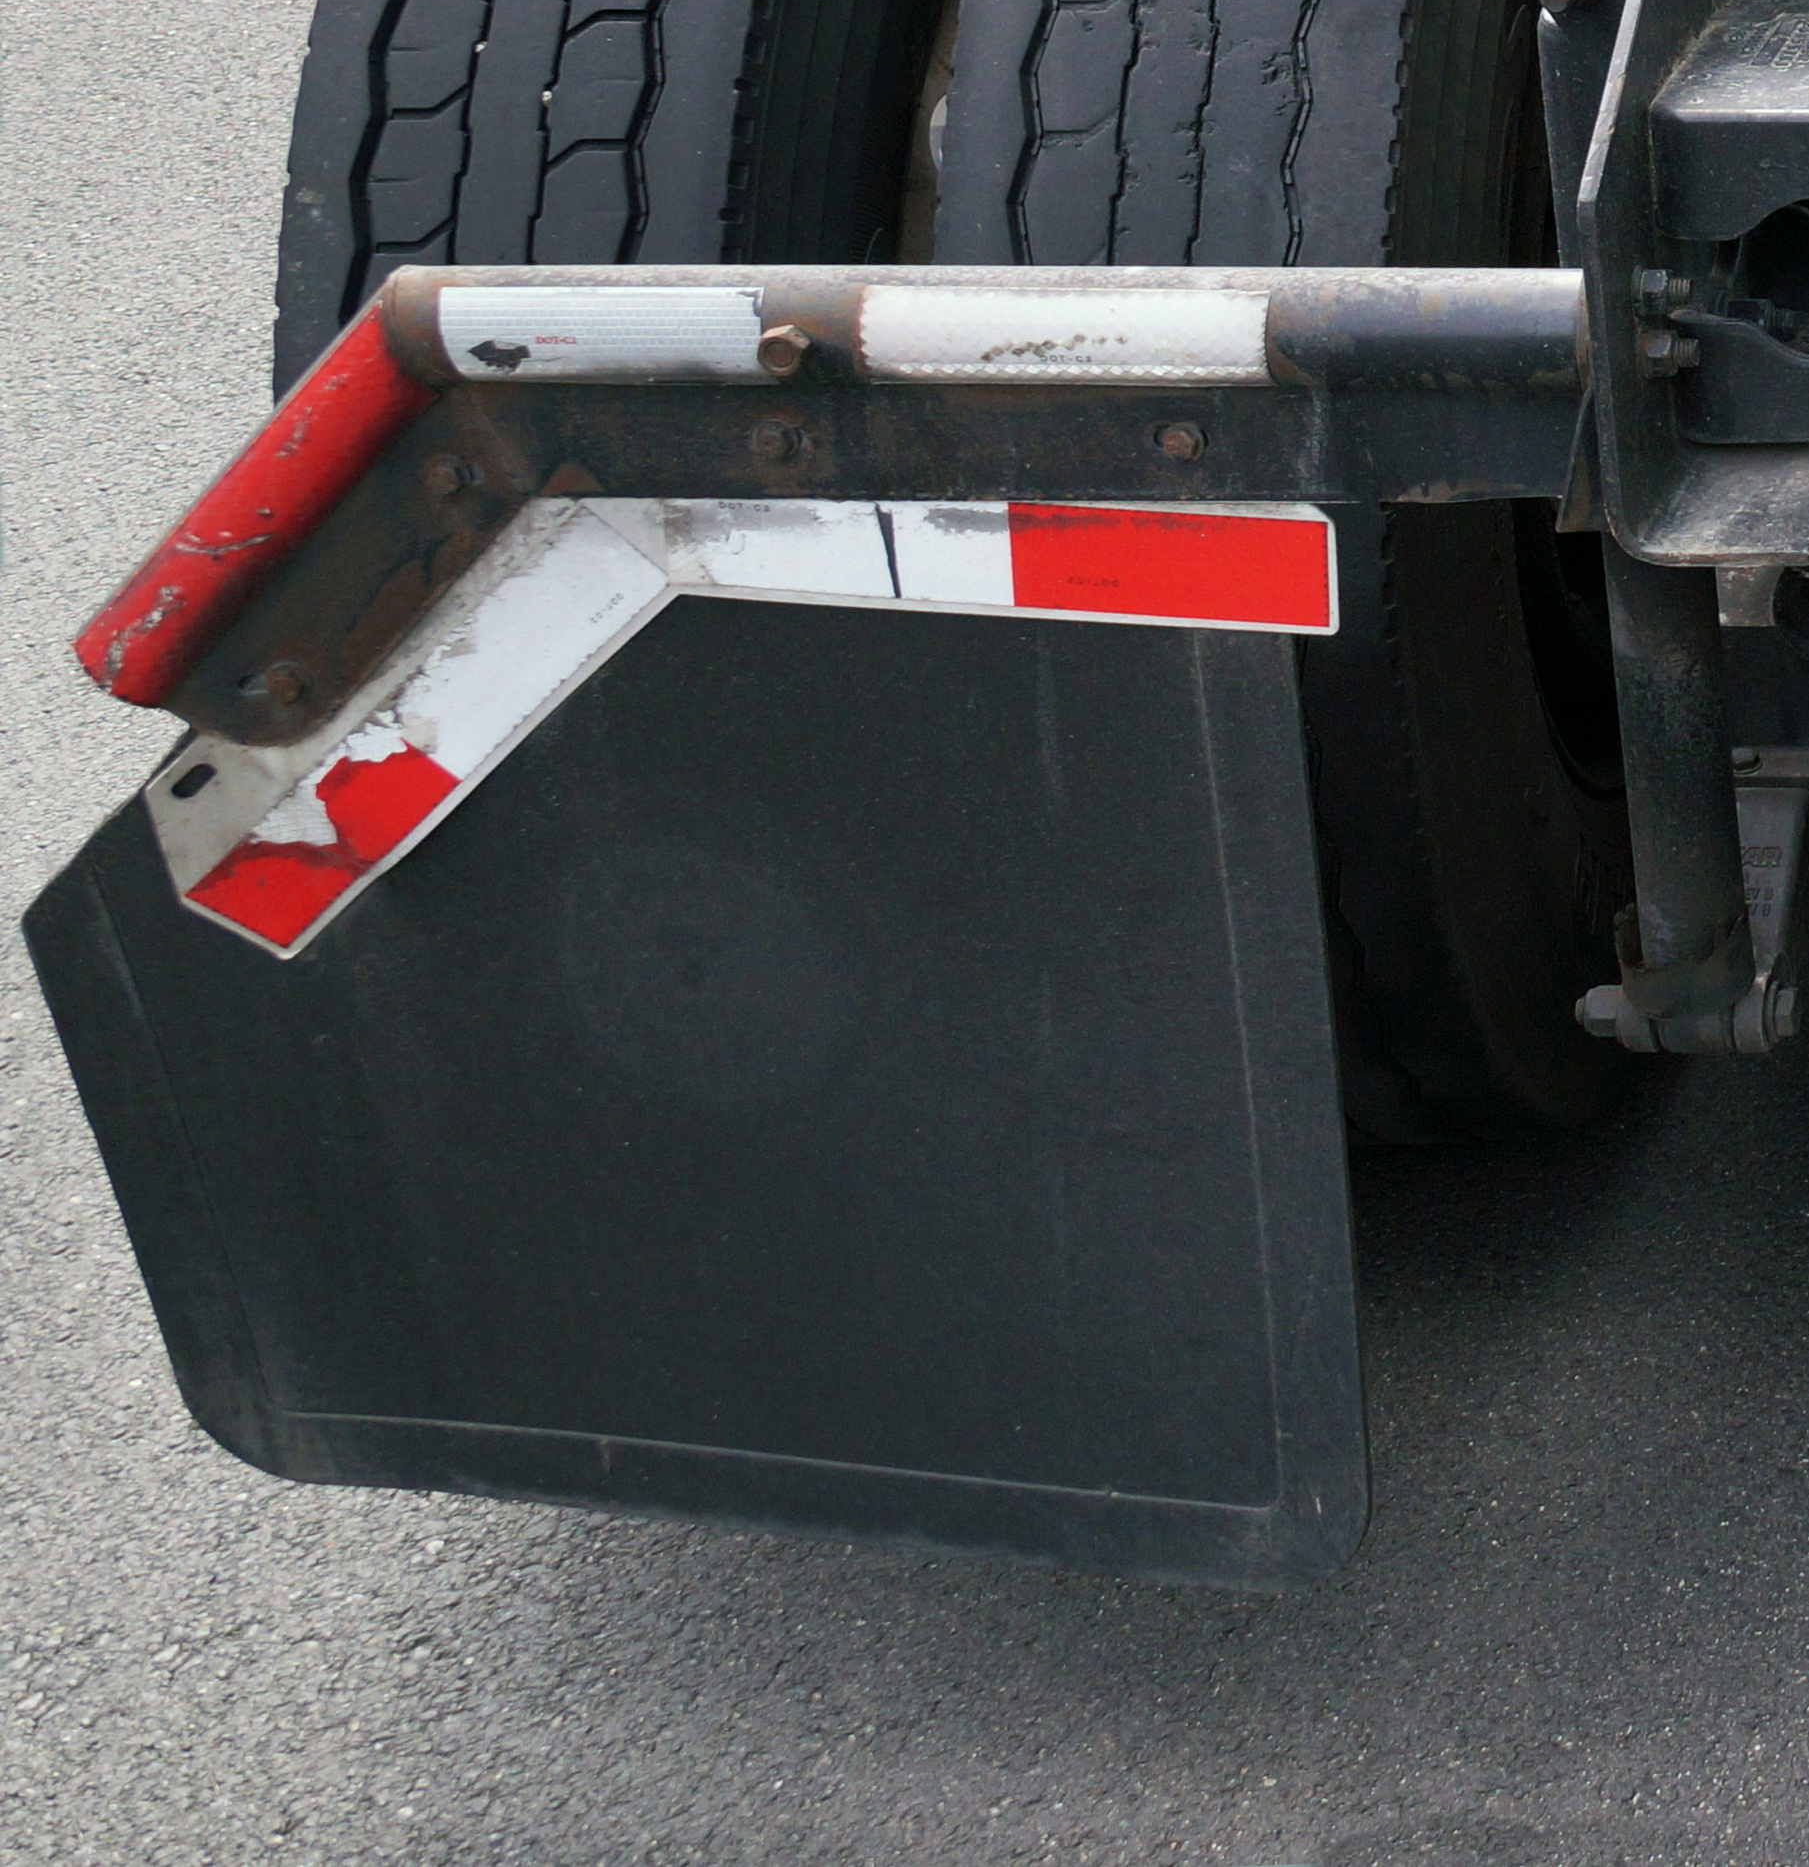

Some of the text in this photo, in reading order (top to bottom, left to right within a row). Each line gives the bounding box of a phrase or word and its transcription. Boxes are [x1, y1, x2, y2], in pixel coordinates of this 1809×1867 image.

[535, 335, 578, 344] DOT-C2
[1040, 355, 1092, 363] DOT-C2
[718, 501, 770, 512] DOT-C2
